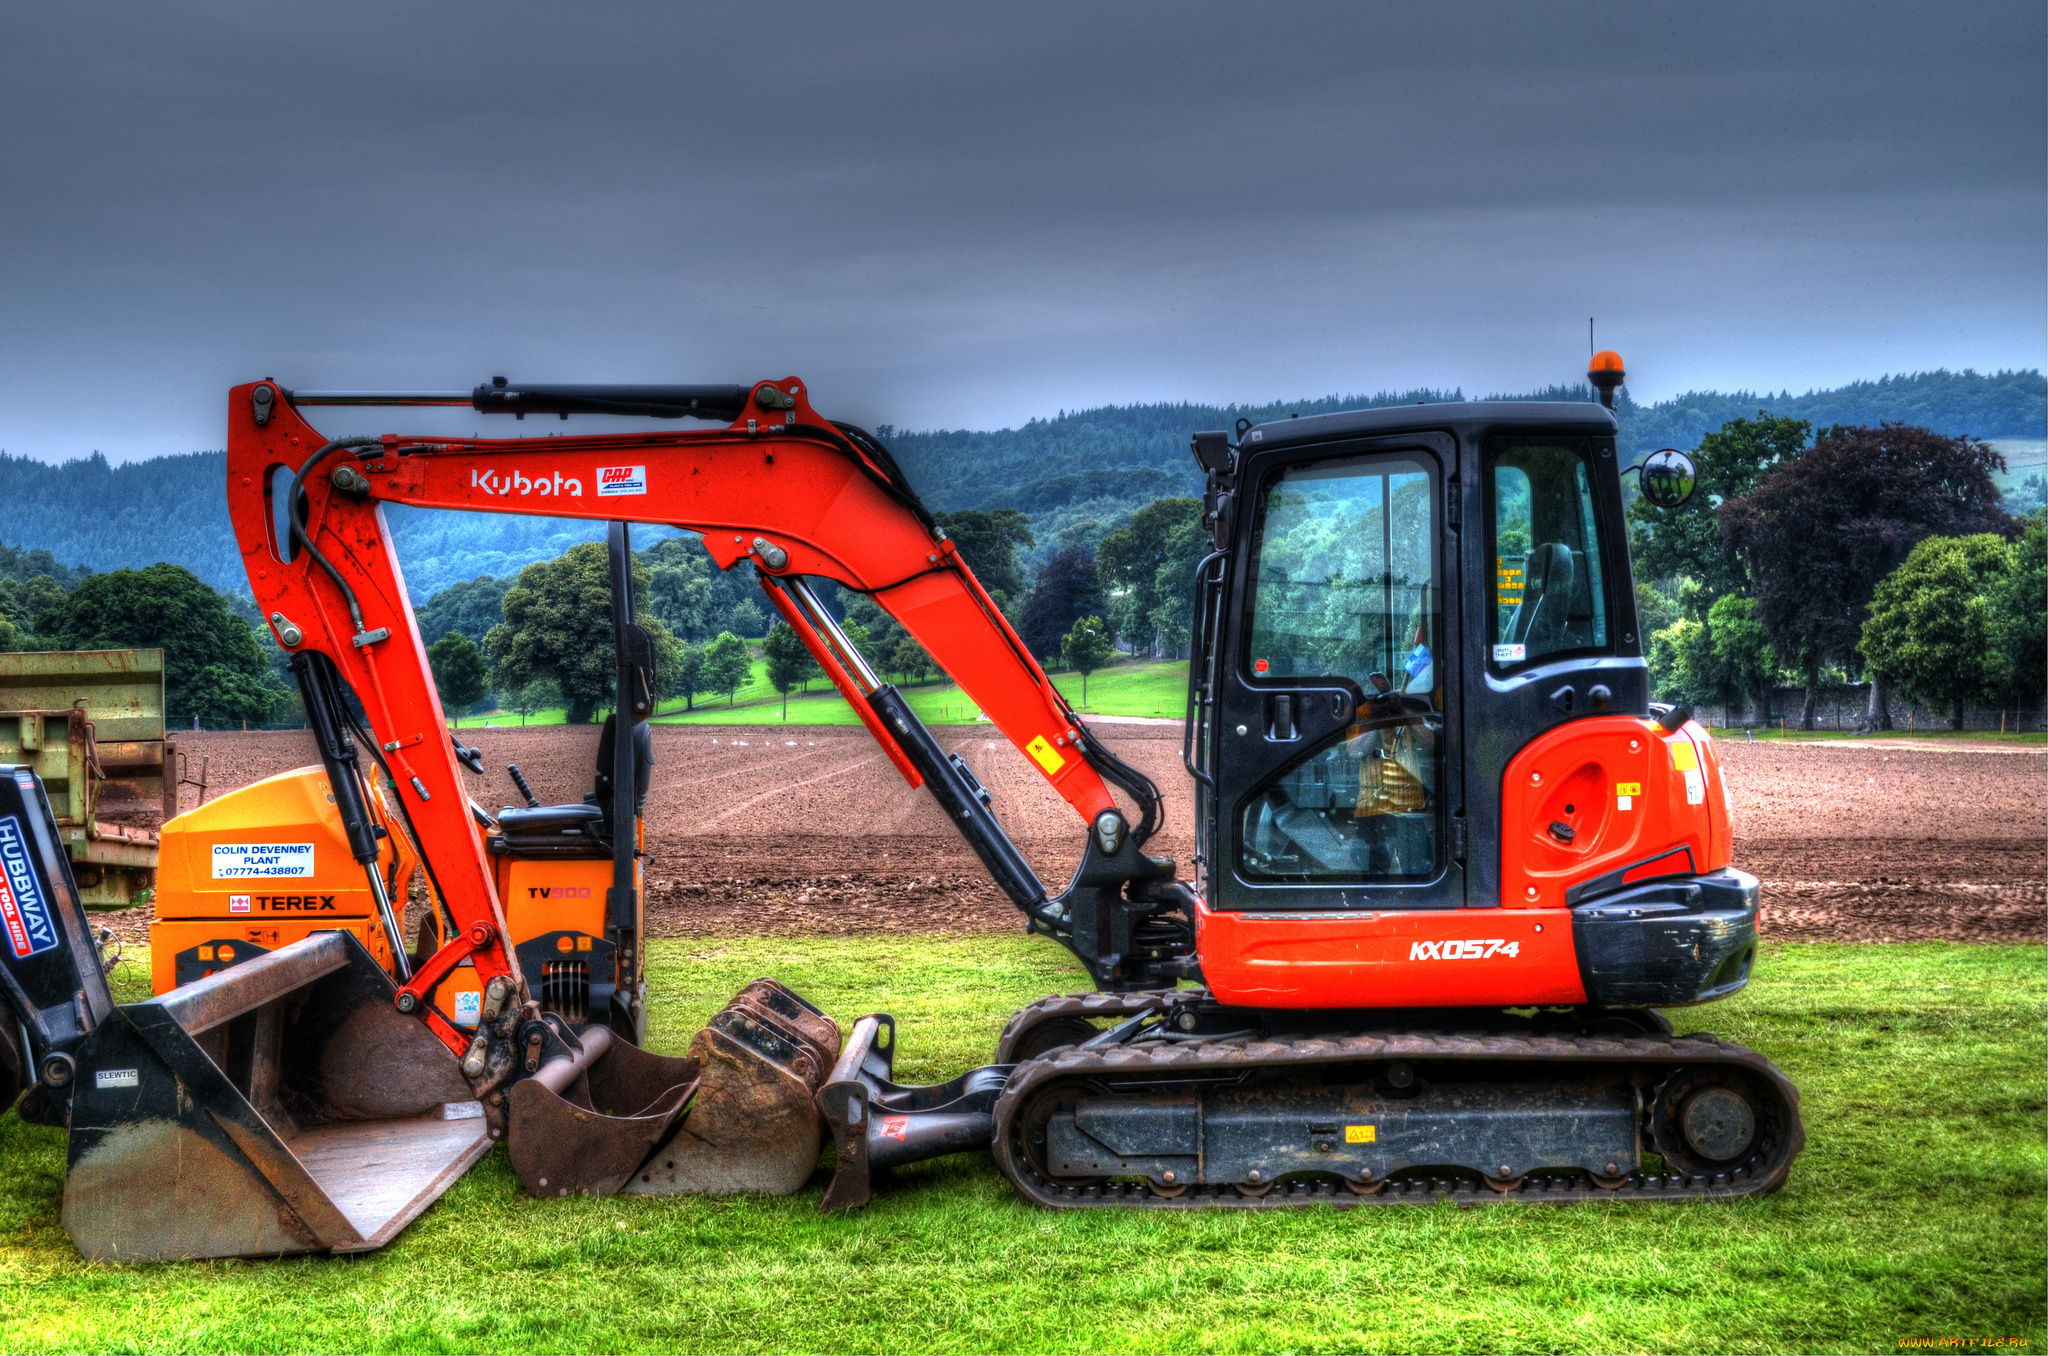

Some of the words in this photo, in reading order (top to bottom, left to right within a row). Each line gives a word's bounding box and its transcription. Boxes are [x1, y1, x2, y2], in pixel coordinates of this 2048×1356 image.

[471, 469, 583, 497] Kubota
[213, 846, 248, 855] COLIN
[251, 845, 312, 854] DEVENNEY
[243, 856, 281, 865] PLANT
[225, 866, 305, 876] 07774-438807
[0, 823, 51, 943] HUBBWAY
[527, 886, 591, 899] TV900
[256, 895, 336, 911] TEREX
[0, 888, 15, 918] TOOL
[9, 920, 27, 949] HIRE
[98, 1070, 137, 1080] SLEWTIC
